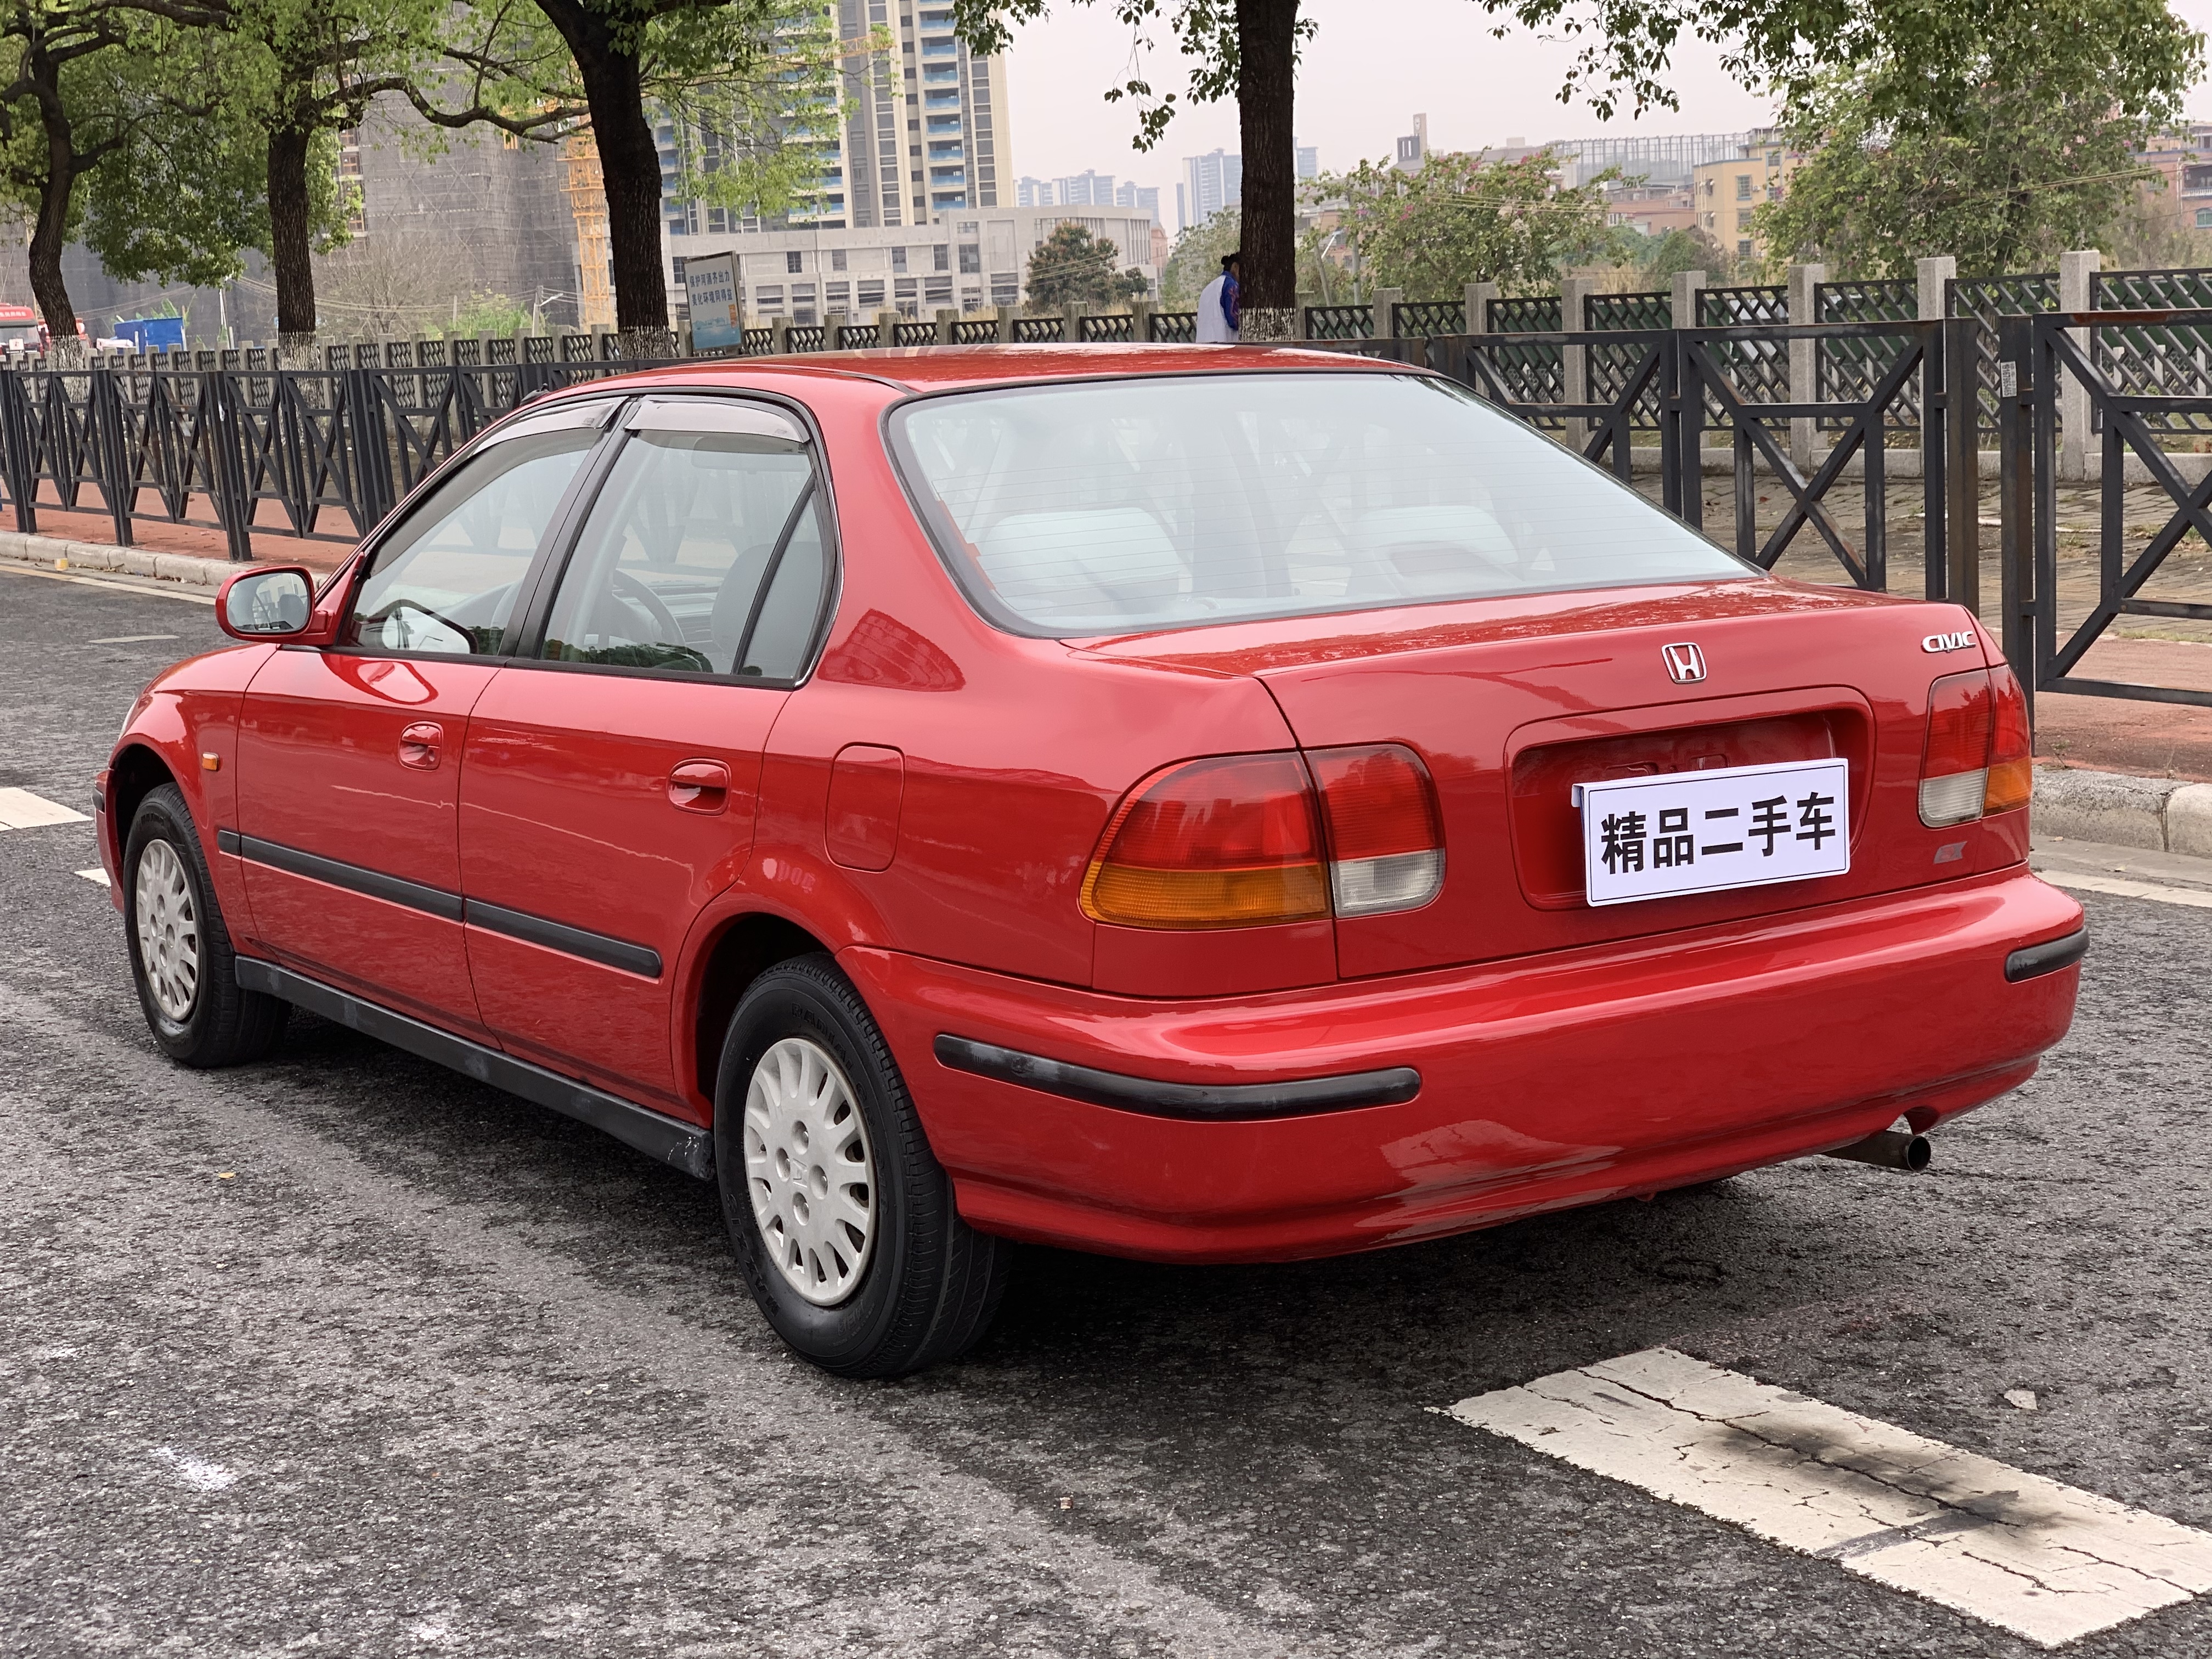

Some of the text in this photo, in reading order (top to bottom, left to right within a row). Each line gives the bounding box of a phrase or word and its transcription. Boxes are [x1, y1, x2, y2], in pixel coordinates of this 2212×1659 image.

[692, 288, 733, 306] 美化环境同得益
[1921, 630, 1976, 653] CIVIC
[1600, 792, 1836, 875] 精品二手车
[792, 1002, 855, 1077] RADIAL
[726, 1194, 781, 1317] MAXXIS
